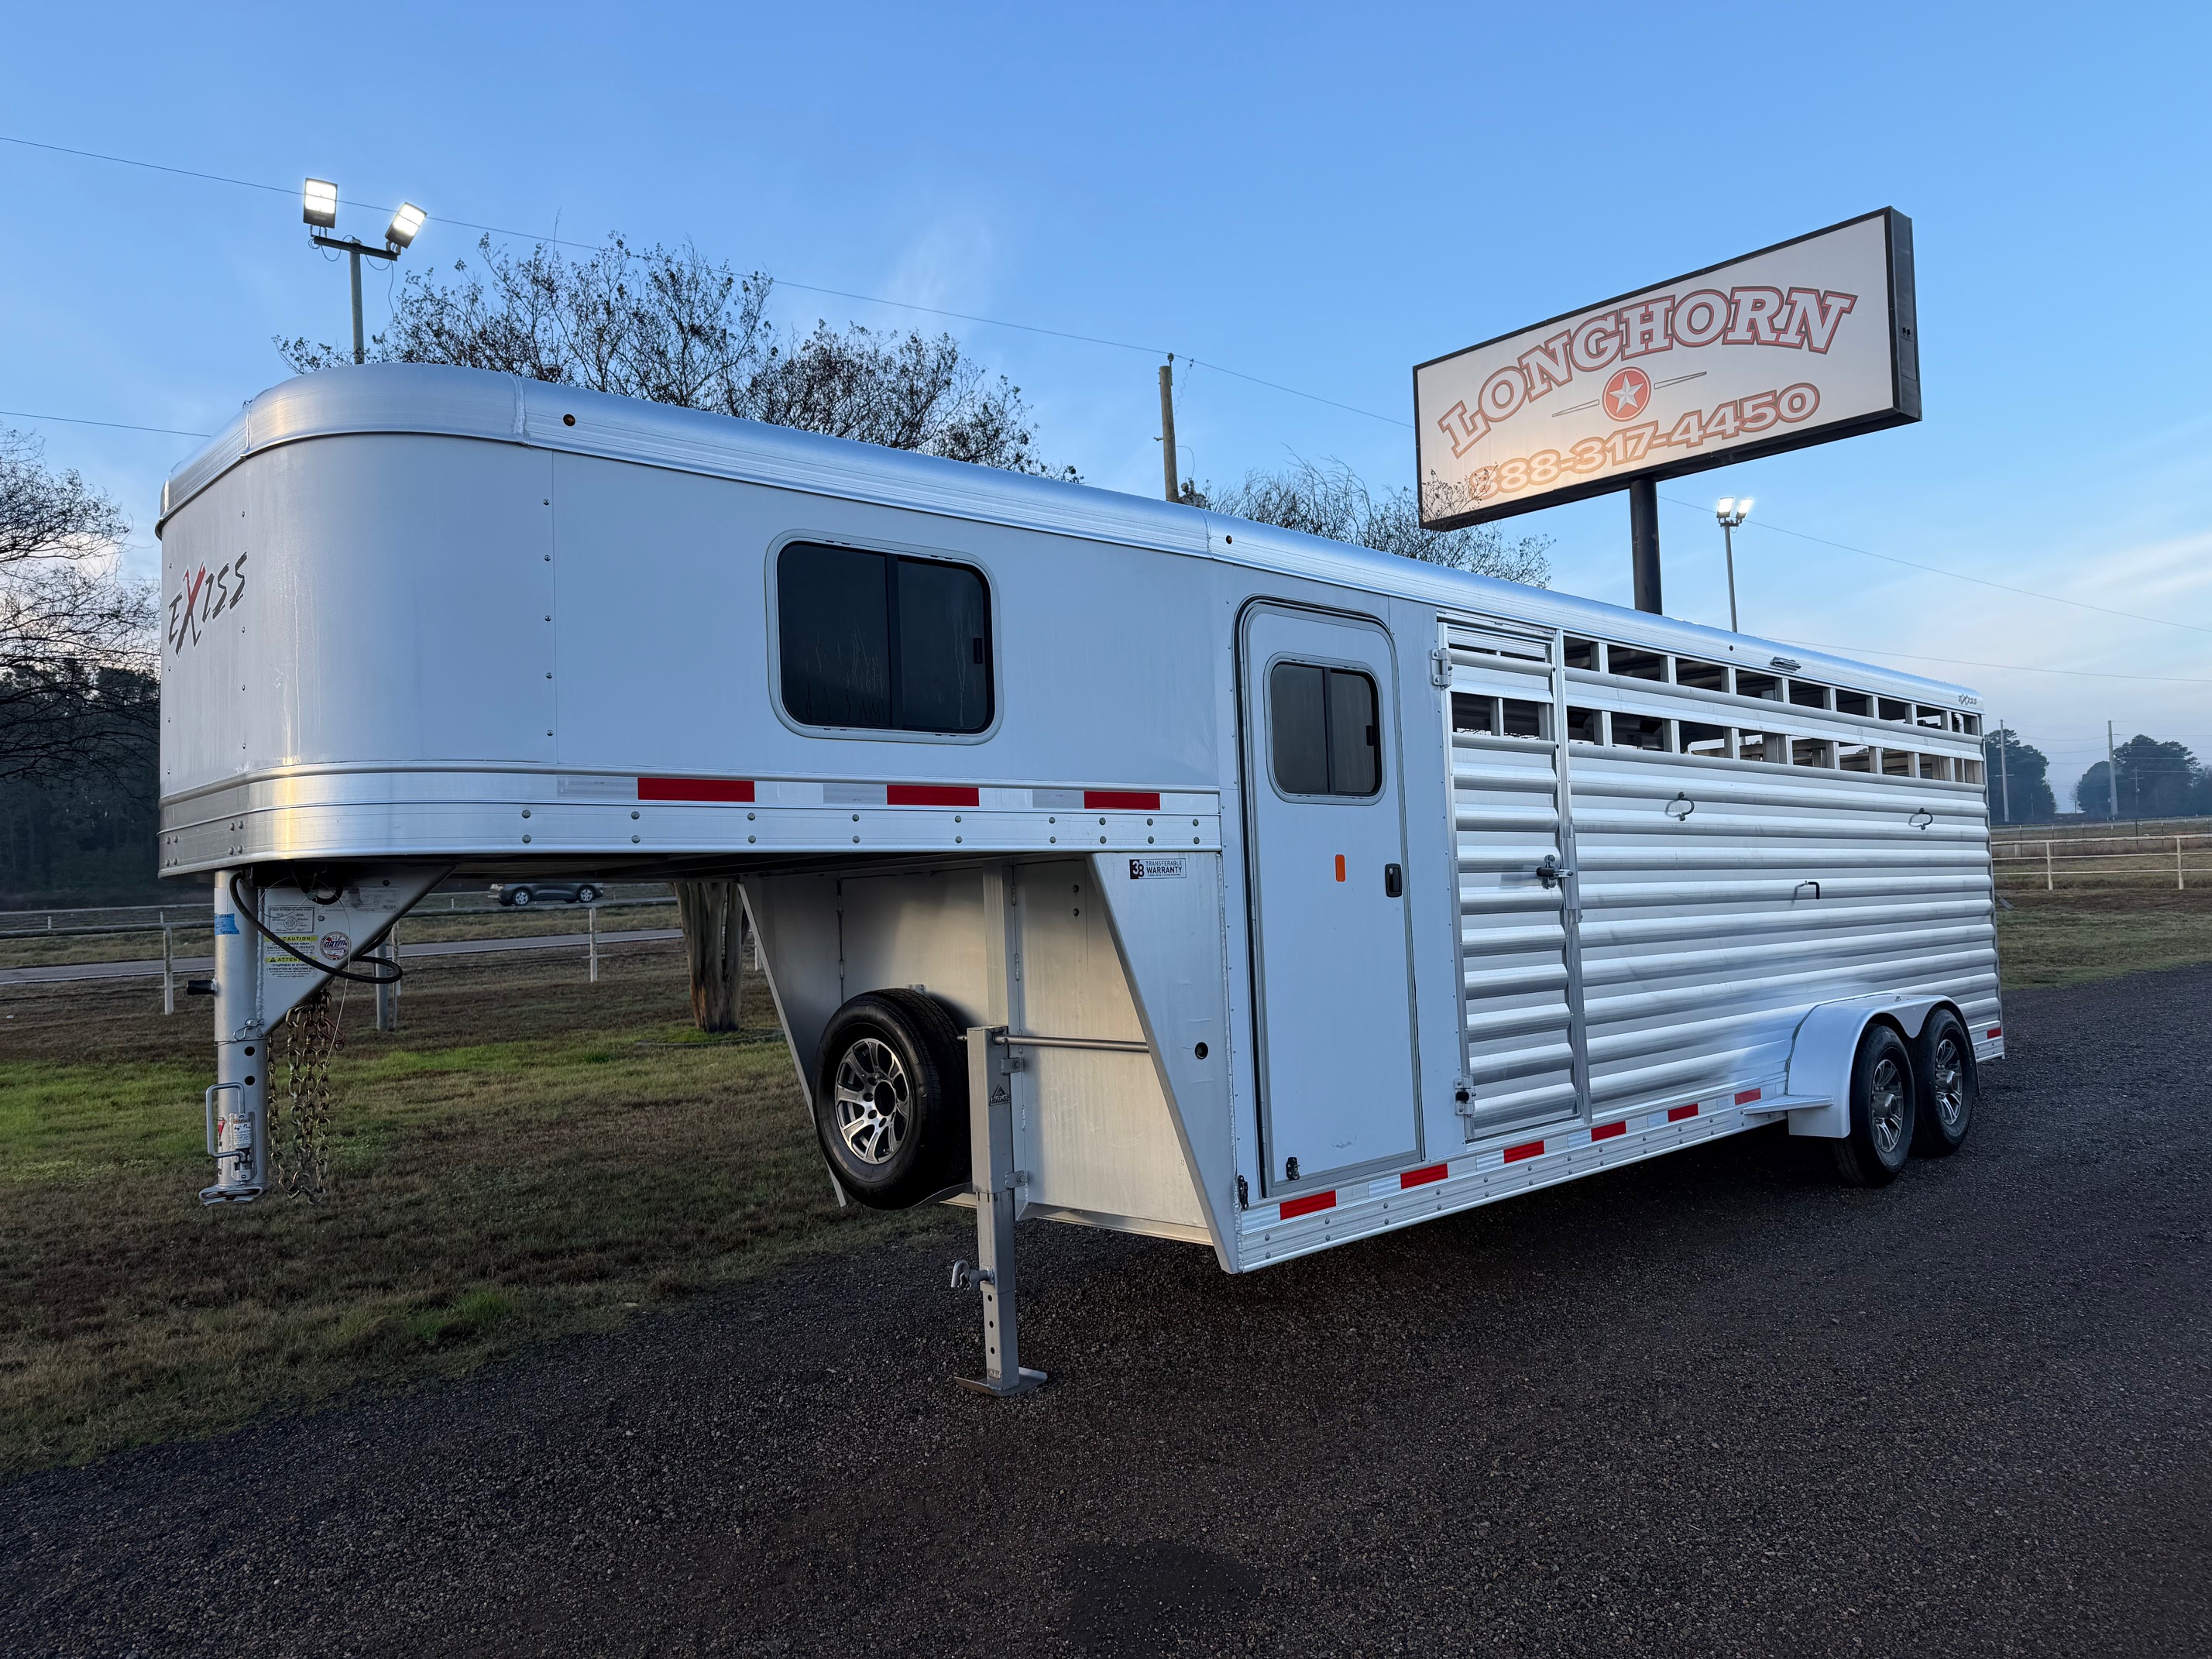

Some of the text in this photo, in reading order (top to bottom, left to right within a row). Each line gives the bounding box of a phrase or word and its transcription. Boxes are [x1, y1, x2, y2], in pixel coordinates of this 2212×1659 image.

[1438, 287, 1858, 459] LONGHORN
[1469, 383, 1820, 500] 888-317-4450
[168, 551, 248, 658] EXISS
[1958, 693, 1977, 706] EXISS
